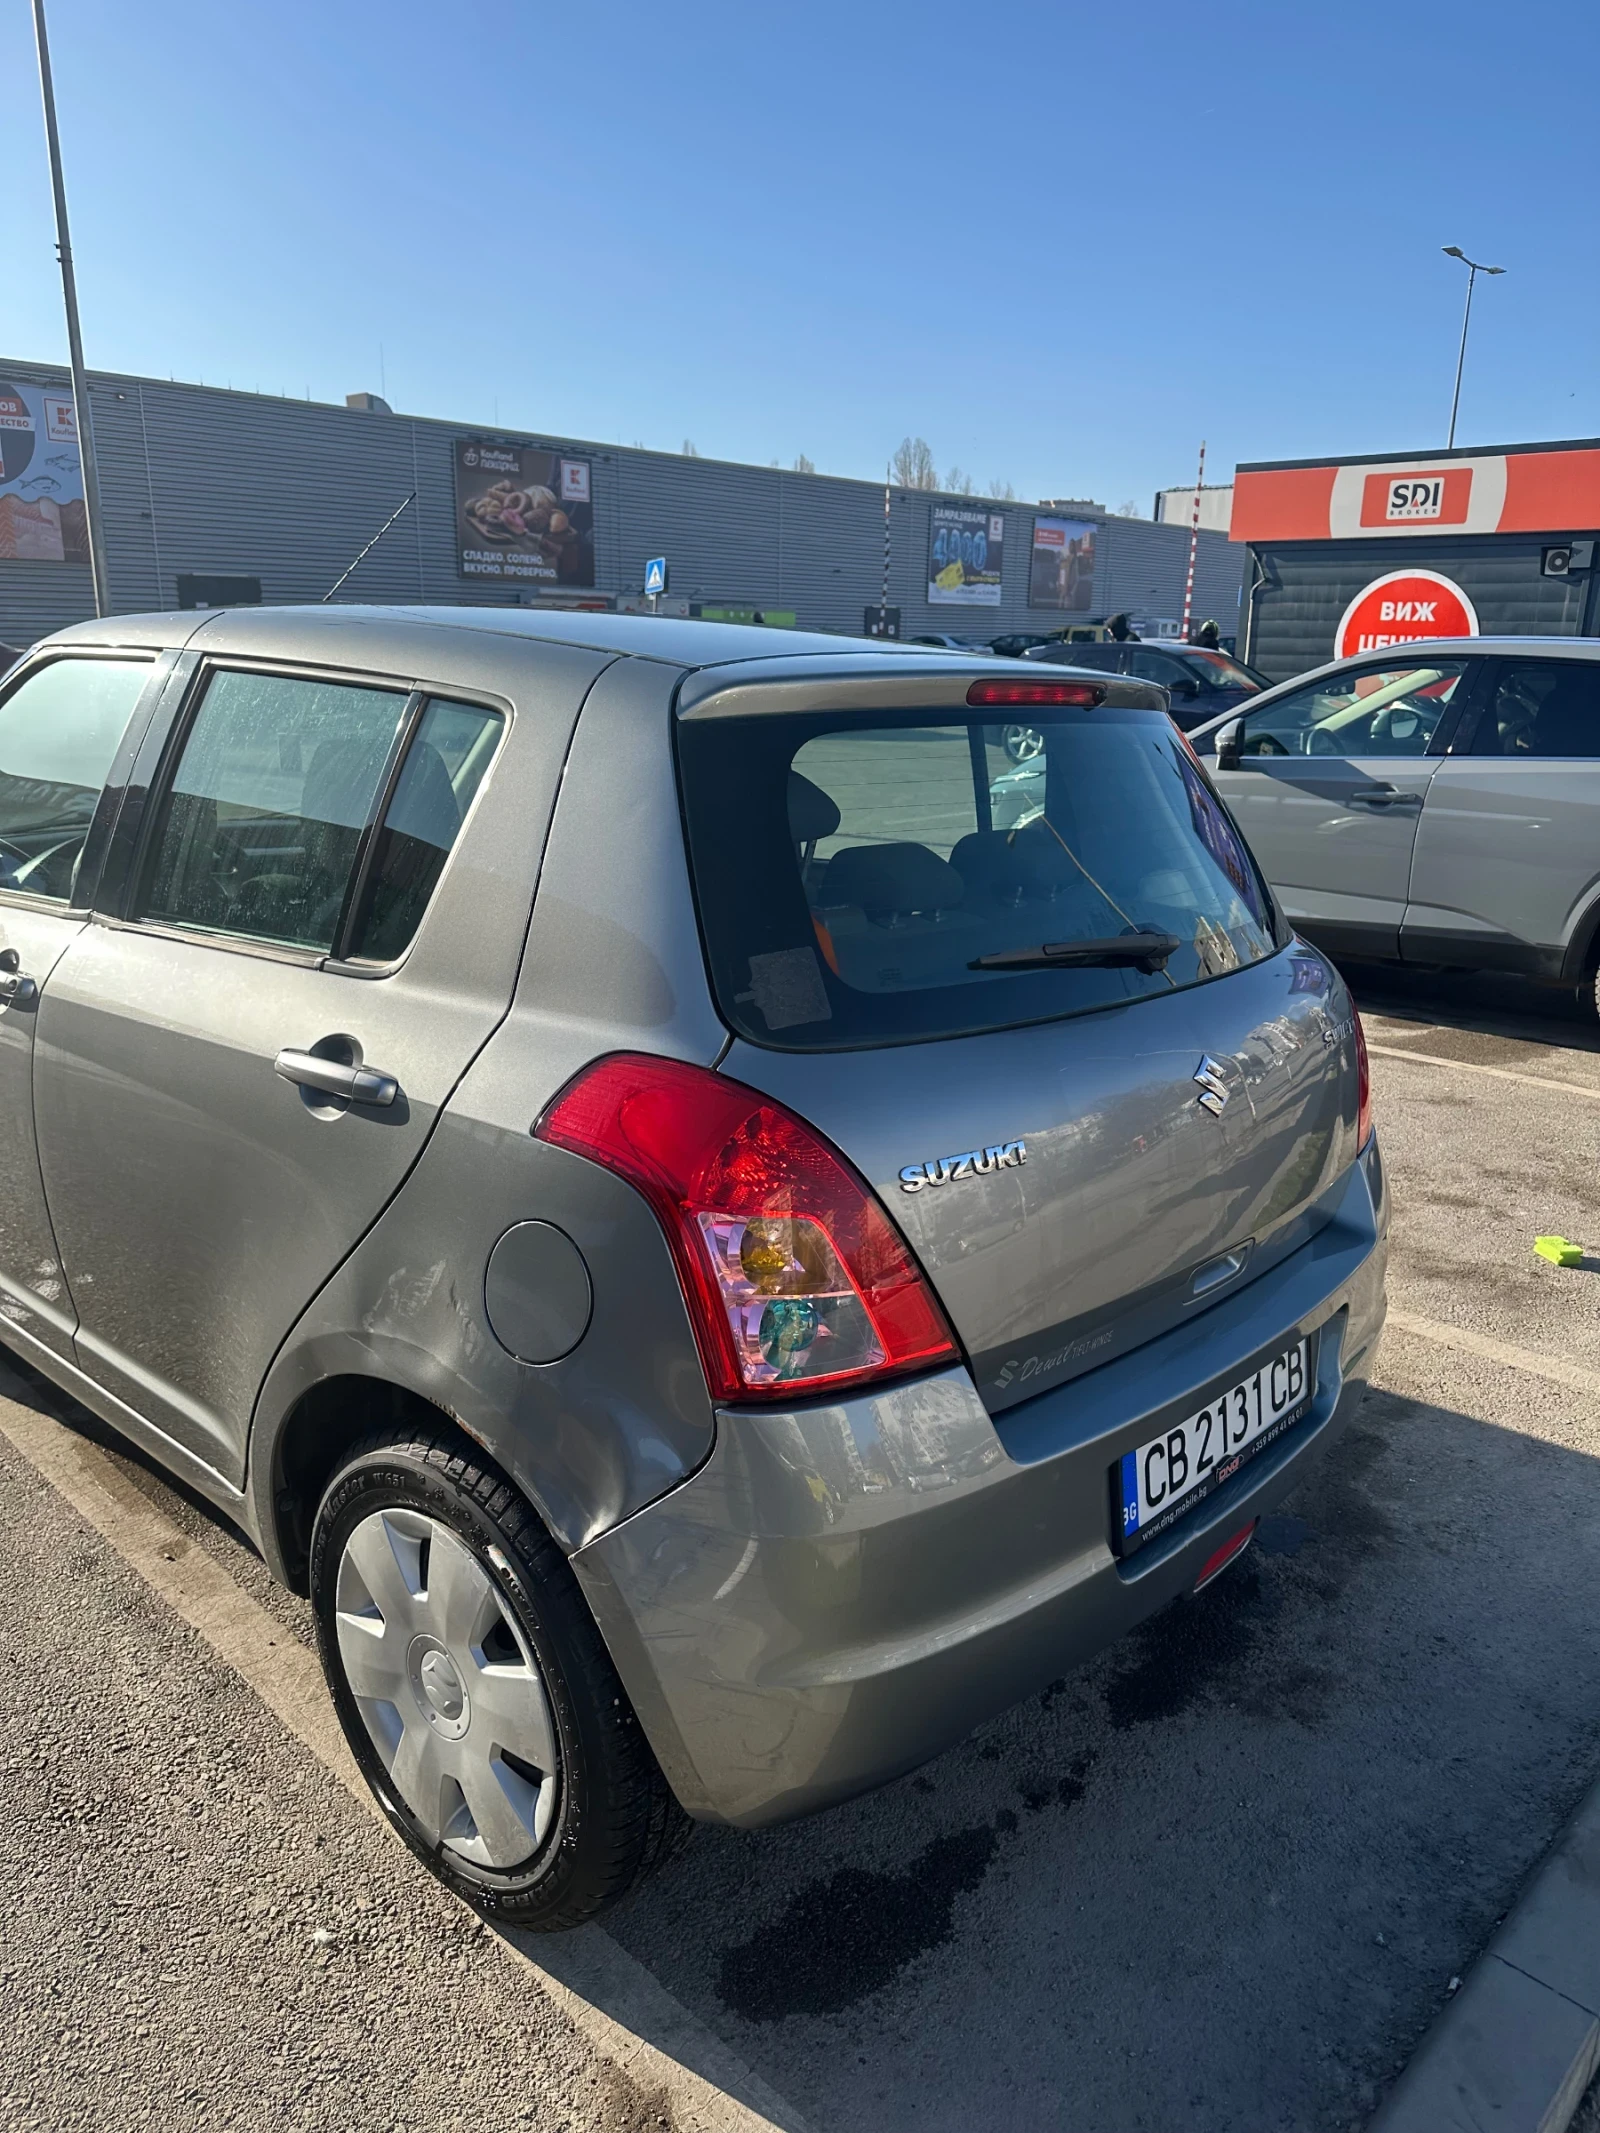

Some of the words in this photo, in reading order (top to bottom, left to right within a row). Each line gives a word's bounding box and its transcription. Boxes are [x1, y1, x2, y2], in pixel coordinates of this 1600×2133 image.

[51, 427, 78, 436] Kauflan
[1391, 482, 1441, 509] SDI
[1389, 508, 1438, 516] BROKER
[1380, 601, 1438, 622] ВИЖ
[899, 1140, 1027, 1193] SUZUKI
